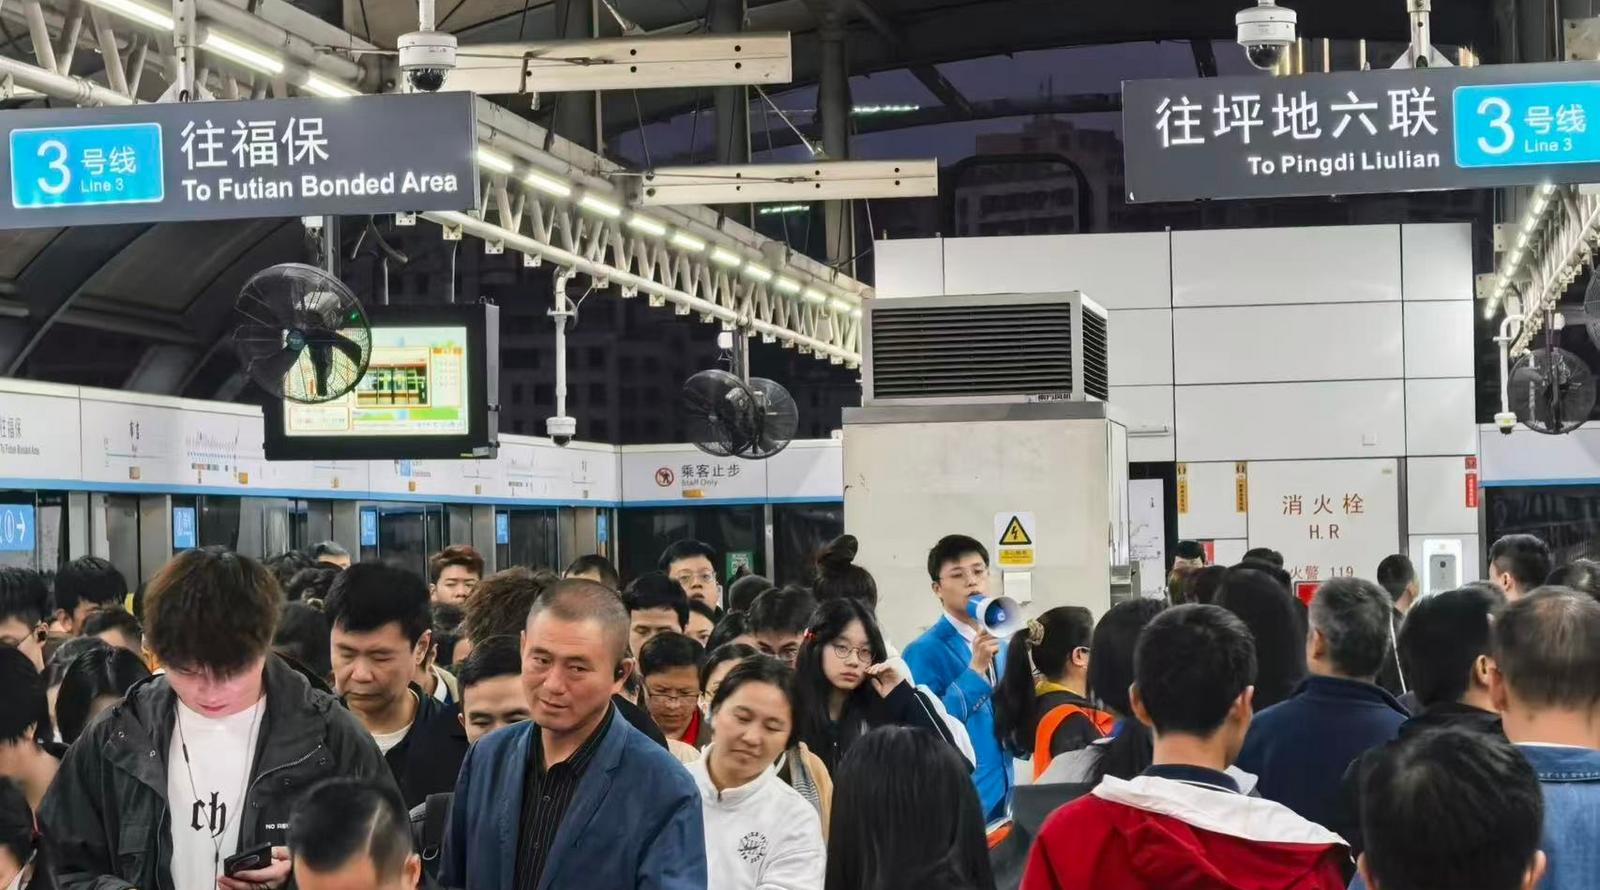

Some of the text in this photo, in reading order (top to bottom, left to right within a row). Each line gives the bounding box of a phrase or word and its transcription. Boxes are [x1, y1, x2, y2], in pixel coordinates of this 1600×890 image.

[1155, 86, 1439, 148] 往坪地六联
[1477, 96, 1587, 155] 3 号线
[180, 117, 330, 170] 往福保
[1524, 137, 1573, 154] Line 3
[37, 140, 138, 195] 3 号线
[1248, 150, 1440, 177] To Pingdi Liulian
[80, 177, 124, 194] Line 3
[181, 170, 458, 202] To Futian Bonded Area
[681, 463, 741, 478] 乘客止步
[700, 478, 719, 488] Only
[1282, 493, 1365, 516] 消火栓
[1290, 566, 1354, 580] 火警 119
